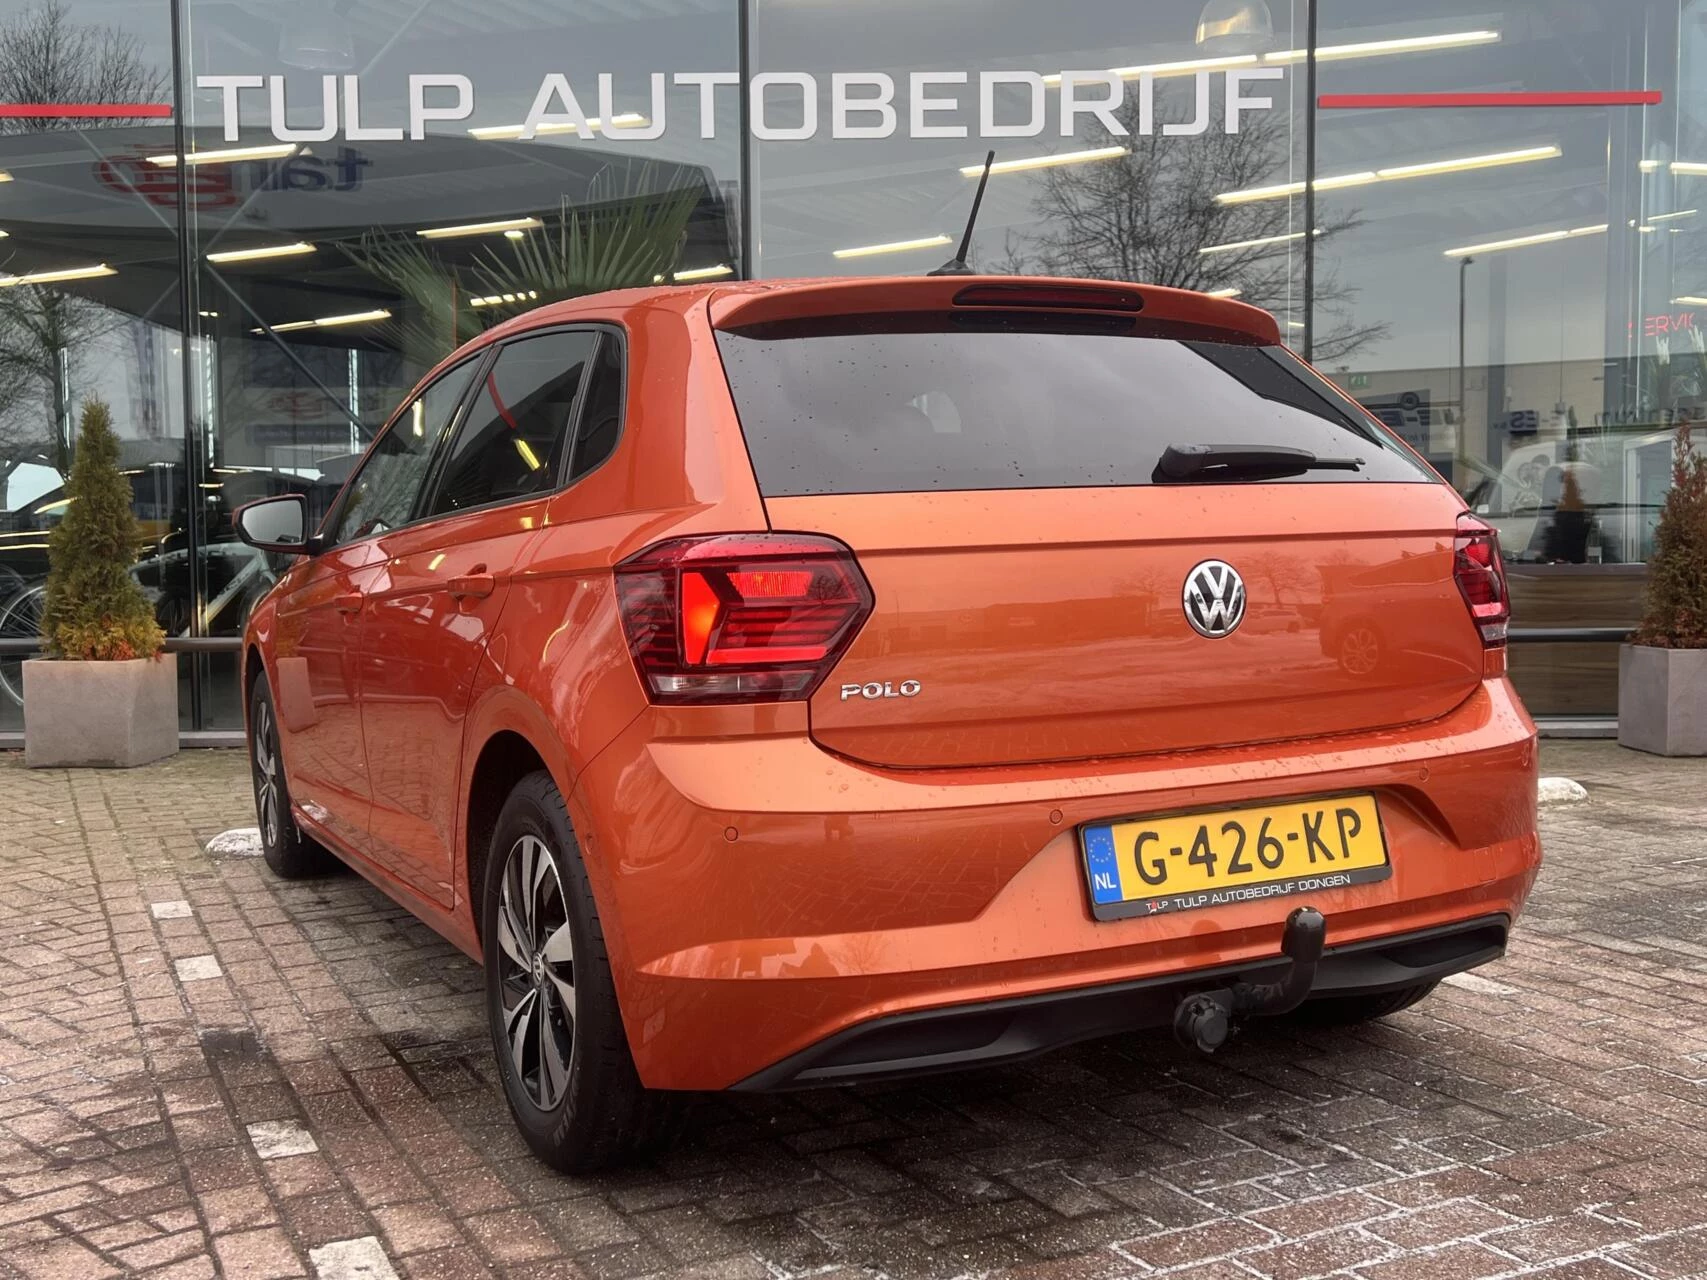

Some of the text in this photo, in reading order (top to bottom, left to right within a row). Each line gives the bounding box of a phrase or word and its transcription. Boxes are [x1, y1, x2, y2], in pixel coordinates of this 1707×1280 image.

[197, 67, 1285, 142] TULP AUTOBEDRIJF
[840, 680, 922, 701] POLO
[1134, 807, 1362, 885] G-426-KP
[1095, 873, 1117, 890] NL
[1174, 894, 1208, 909] TULP
[1211, 882, 1295, 904] AUTOBEDRIJF
[1298, 874, 1351, 891] DONGEN
